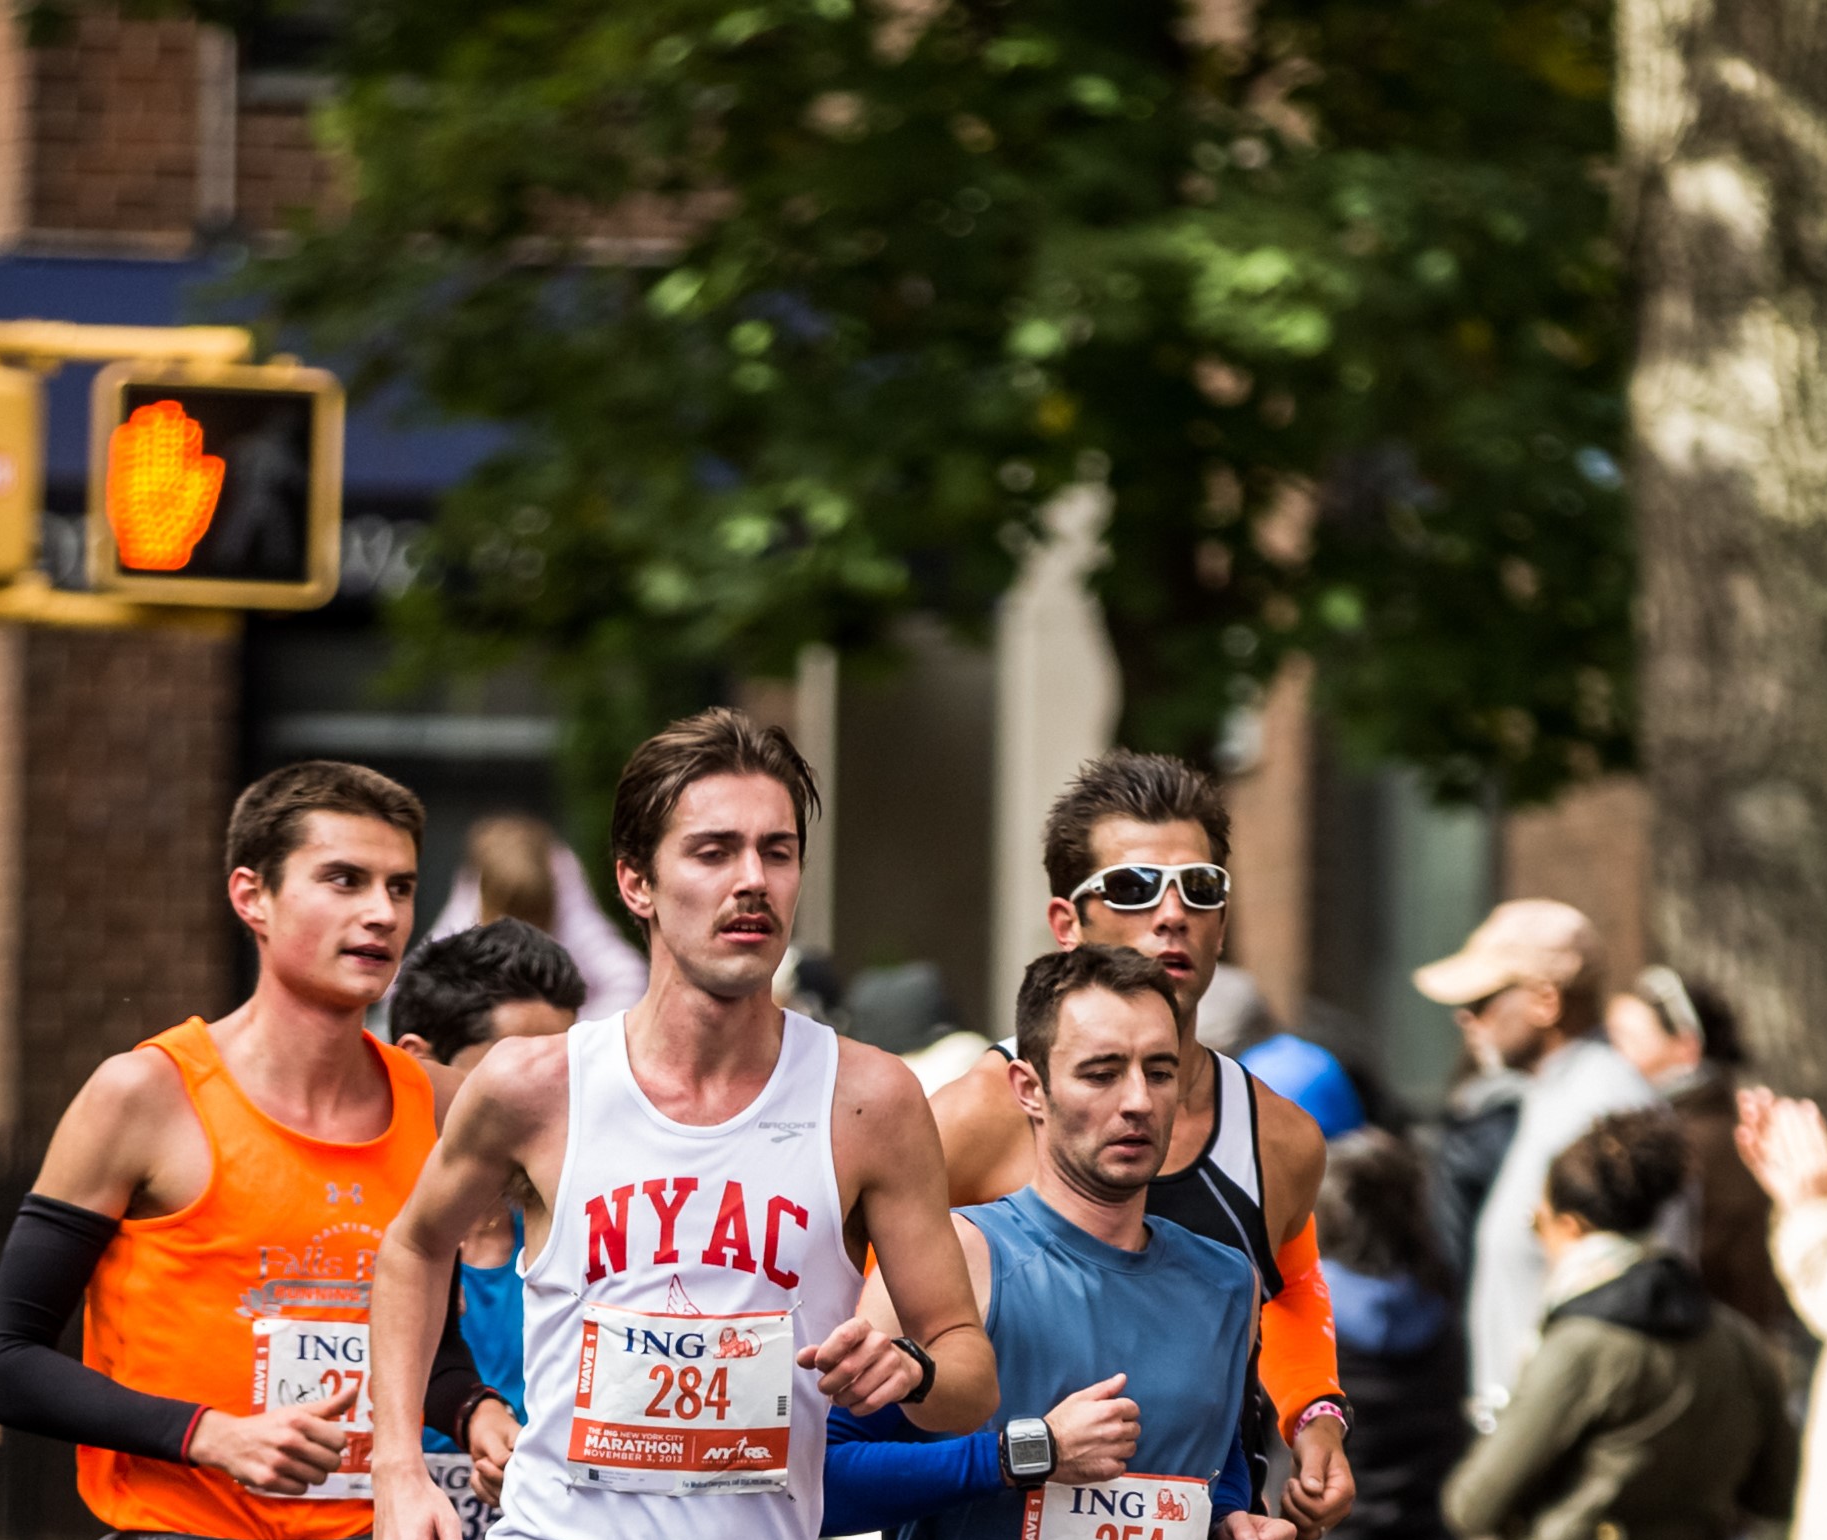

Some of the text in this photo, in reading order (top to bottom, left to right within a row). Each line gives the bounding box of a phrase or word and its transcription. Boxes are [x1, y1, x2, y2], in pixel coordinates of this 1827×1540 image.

[758, 1121, 816, 1130] BROOKS
[585, 1177, 809, 1290] NYAC
[296, 1334, 365, 1362] ING
[623, 1326, 705, 1358] ING
[578, 1333, 597, 1395] WAVE 1
[253, 1359, 268, 1405] WAVE
[645, 1364, 731, 1420] 284
[585, 1434, 684, 1455] MARATHON
[620, 1429, 640, 1439] NEW
[642, 1431, 664, 1441] YORK
[665, 1433, 684, 1442] CITY
[583, 1448, 642, 1462] NOVEMBER
[659, 1454, 683, 1463] 2013
[1030, 1499, 1041, 1507] 1
[1069, 1487, 1146, 1518] ING
